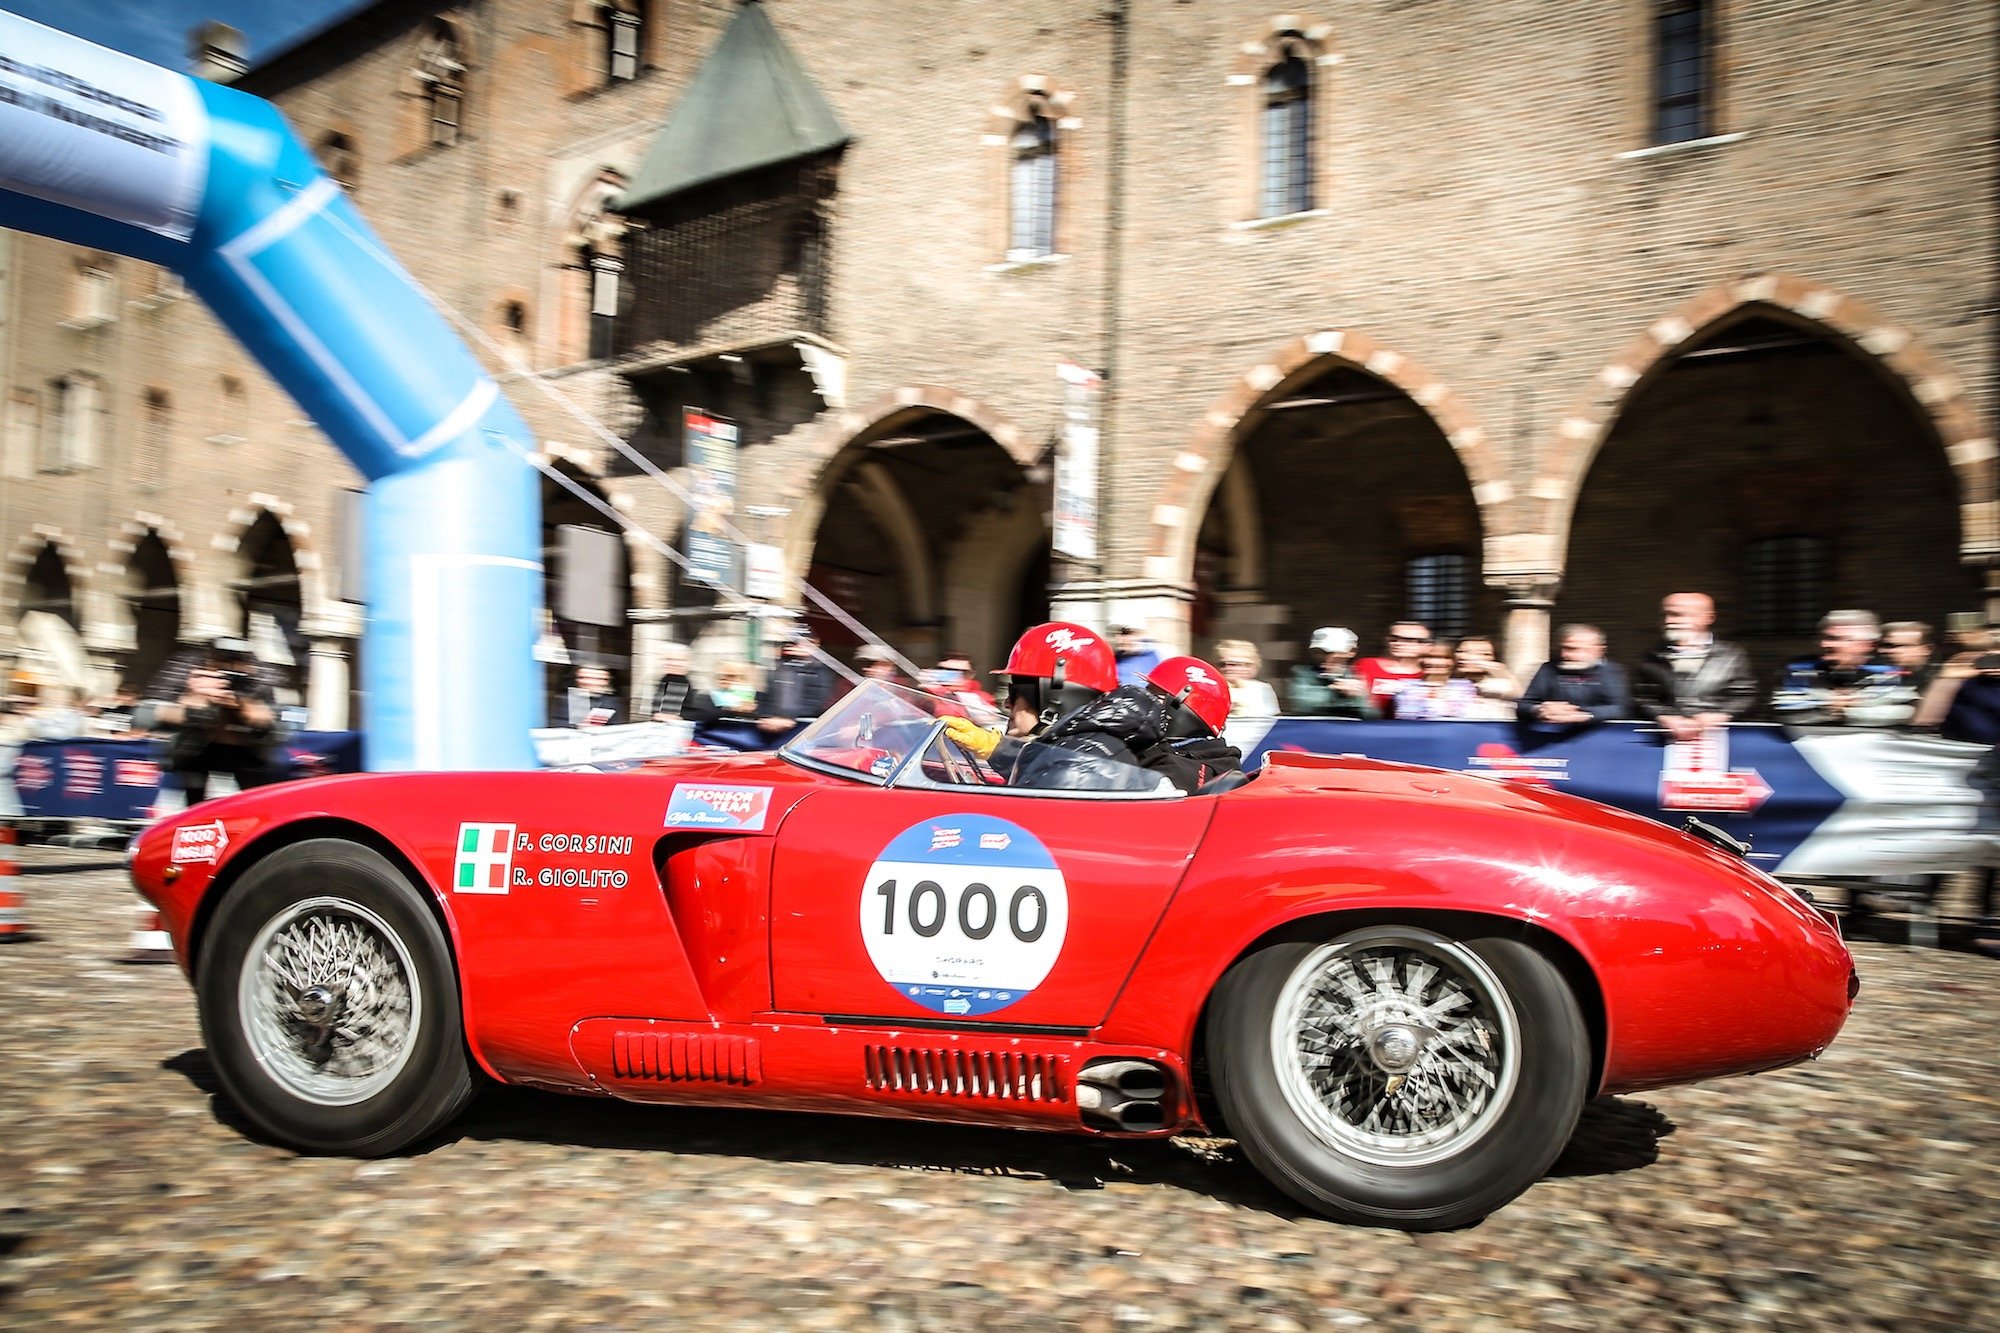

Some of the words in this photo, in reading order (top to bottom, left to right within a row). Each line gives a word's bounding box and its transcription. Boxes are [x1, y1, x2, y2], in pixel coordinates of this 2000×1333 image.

[685, 789, 755, 803] SPONSOR
[711, 801, 751, 813] TEAM
[516, 833, 535, 851] F.
[539, 834, 633, 855] CORSINI
[512, 867, 534, 886] R.
[538, 868, 628, 888] GIOLITO
[877, 879, 1048, 943] 1000
